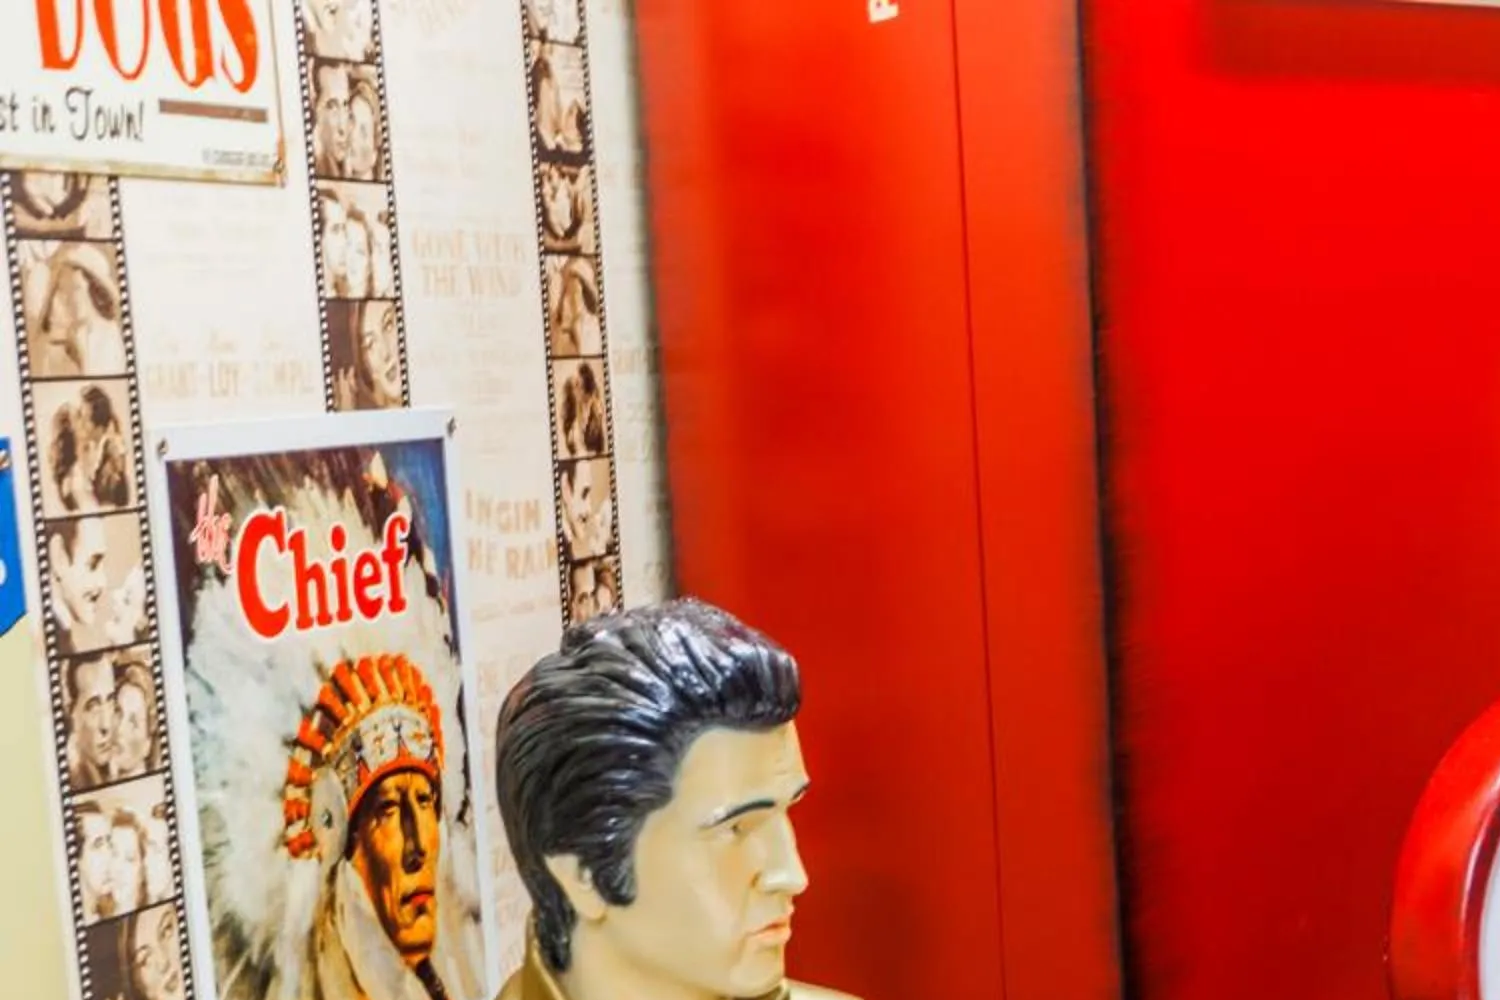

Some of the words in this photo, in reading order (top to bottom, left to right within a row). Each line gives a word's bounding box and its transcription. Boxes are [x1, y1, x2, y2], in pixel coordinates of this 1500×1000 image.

[32, 95, 56, 134] in
[65, 86, 144, 141] Town!
[235, 503, 410, 641] Chief
